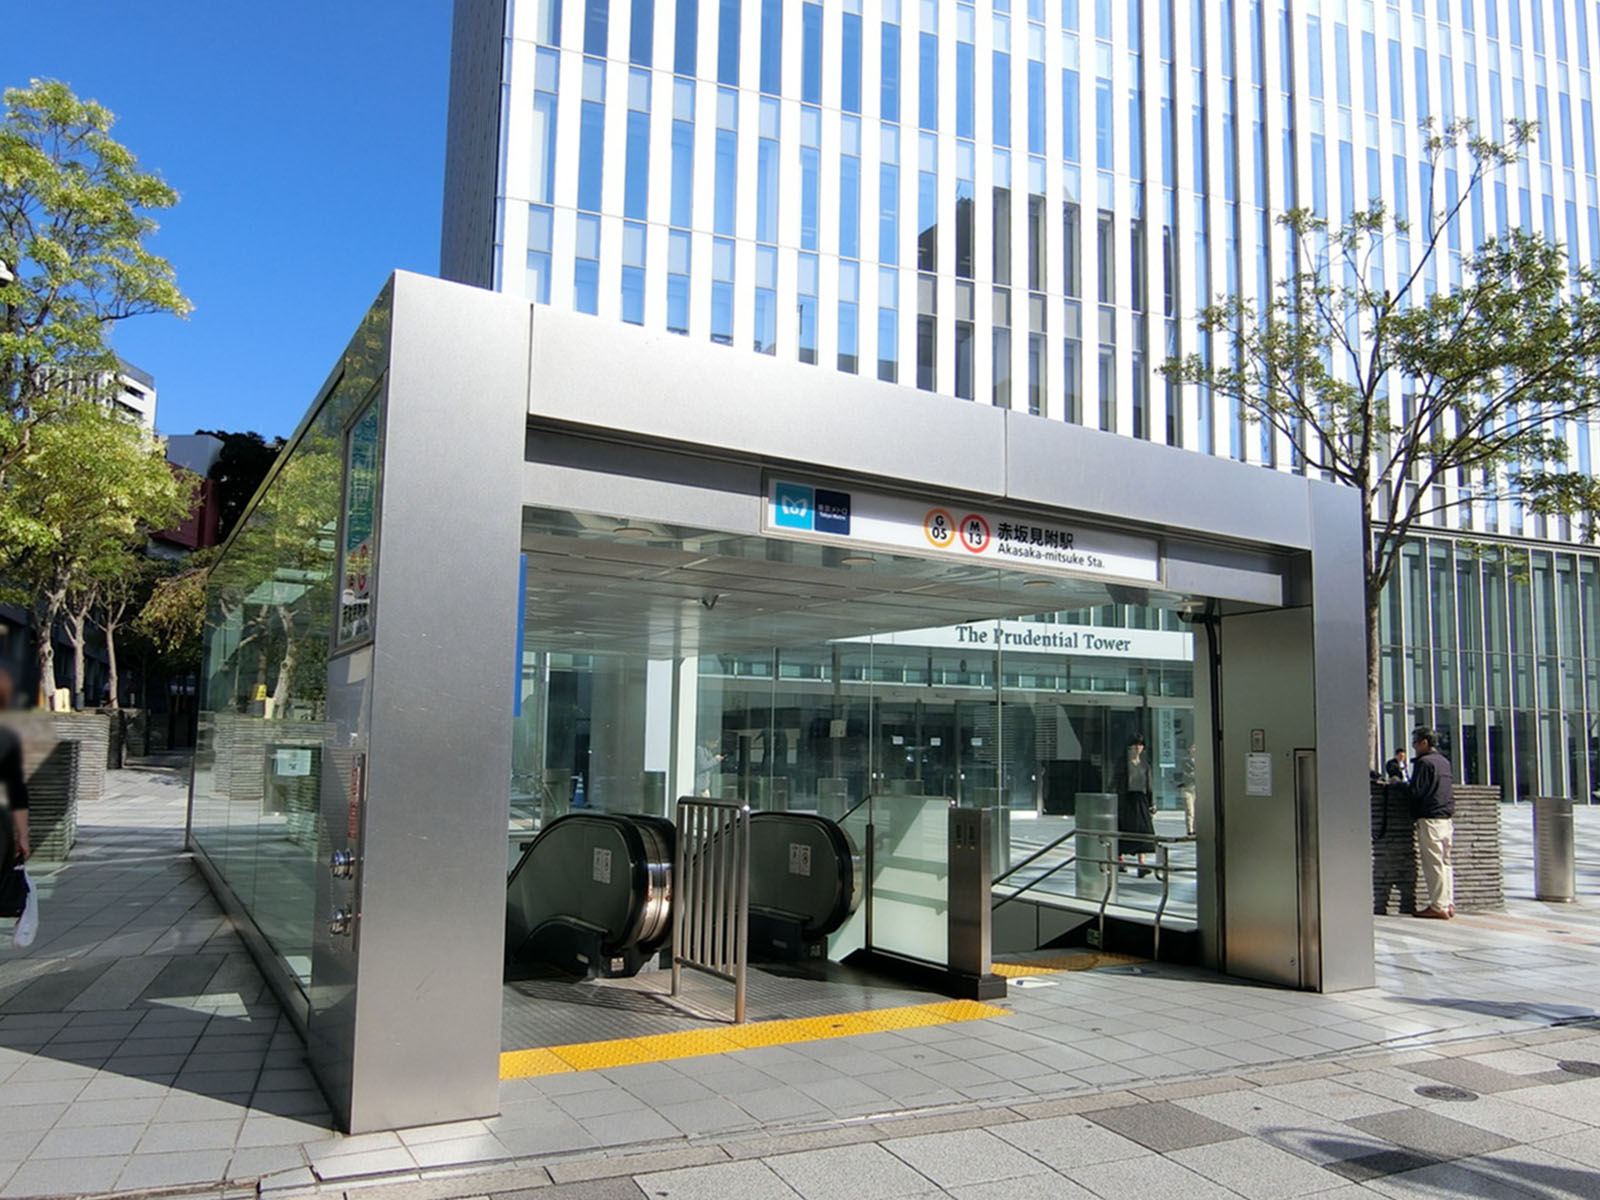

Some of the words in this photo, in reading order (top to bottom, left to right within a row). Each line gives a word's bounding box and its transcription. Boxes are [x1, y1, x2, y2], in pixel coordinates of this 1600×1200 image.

[935, 515, 945, 527] G
[970, 521, 981, 532] M
[932, 527, 947, 540] 05
[969, 532, 982, 546] 13
[997, 522, 1074, 550] 赤坂見附駅
[998, 544, 1085, 566] Akasaka-mitsuke
[1087, 555, 1106, 569] Sta.
[955, 626, 988, 644] The
[993, 628, 1078, 649] Prudential
[1082, 634, 1131, 651] Tower
